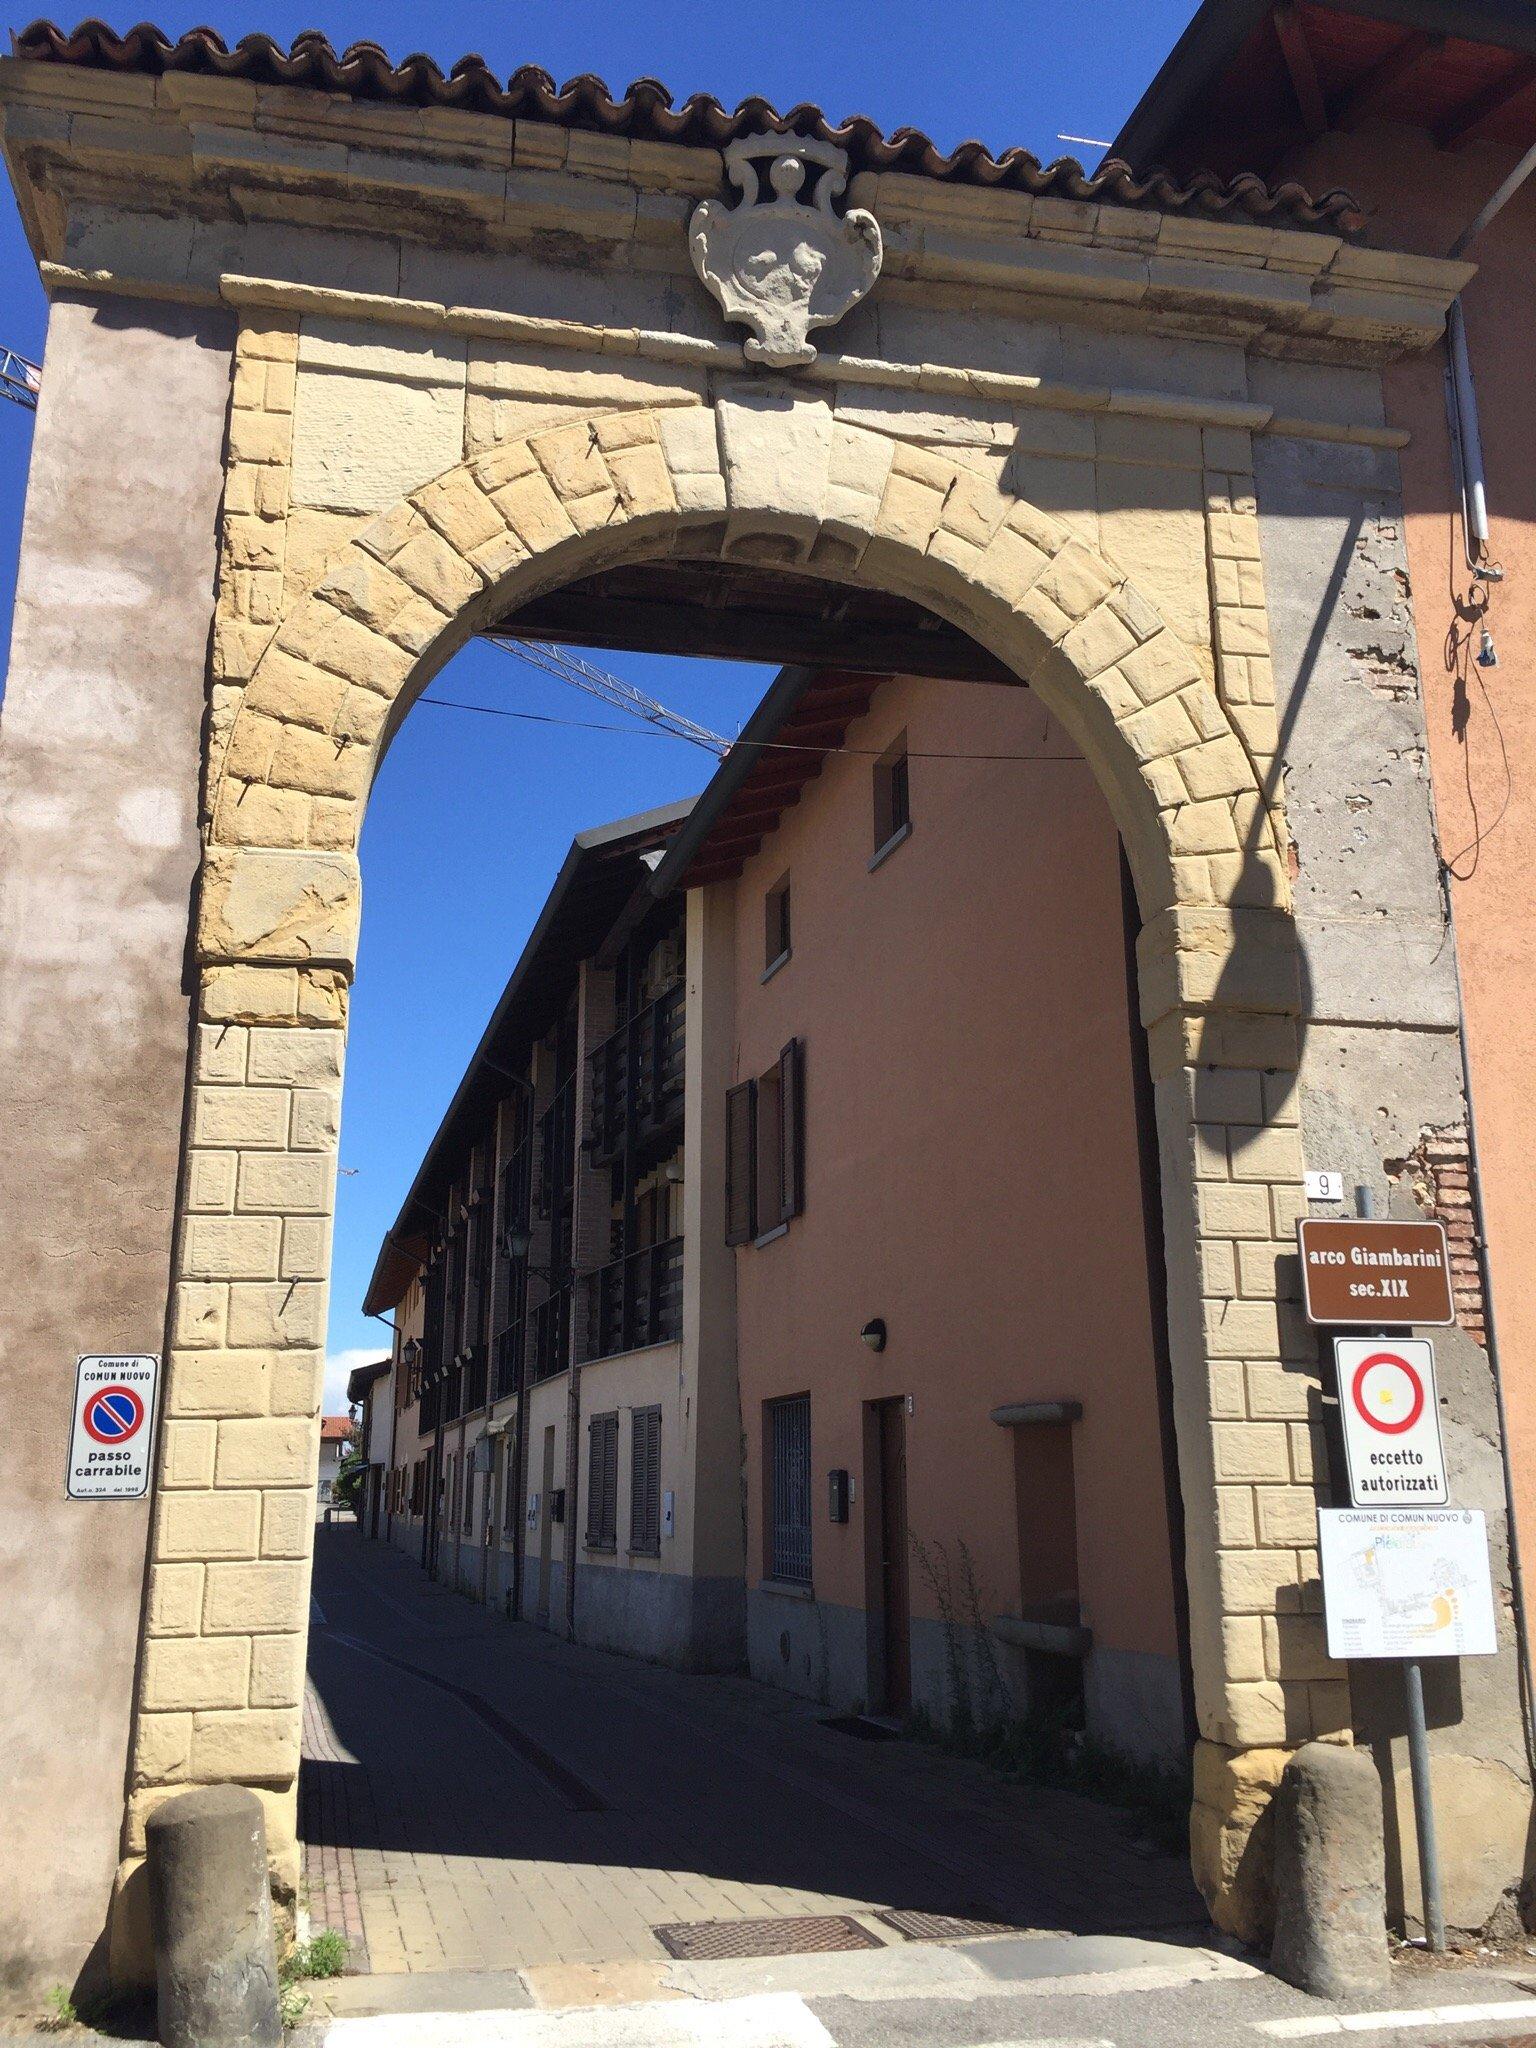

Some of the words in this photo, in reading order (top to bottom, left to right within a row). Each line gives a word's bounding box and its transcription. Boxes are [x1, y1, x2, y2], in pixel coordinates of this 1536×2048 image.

[1318, 1174, 1330, 1196] 9
[1309, 1250, 1346, 1265] arco
[1351, 1246, 1442, 1267] Giambarini
[1349, 1278, 1410, 1298] sec.XIX
[98, 1359, 129, 1368] Comune
[131, 1359, 139, 1367] di
[84, 1372, 117, 1381] COMUN
[120, 1371, 151, 1380] NUOVO
[88, 1451, 131, 1463] passo
[1370, 1450, 1423, 1465] eccetto
[75, 1464, 142, 1477] carrabile
[1361, 1474, 1439, 1491] autorizzati
[1338, 1514, 1377, 1523] COMUNE
[1380, 1514, 1389, 1522] DI
[1391, 1514, 1425, 1522] COMUN
[1427, 1513, 1459, 1522] NUOVO
